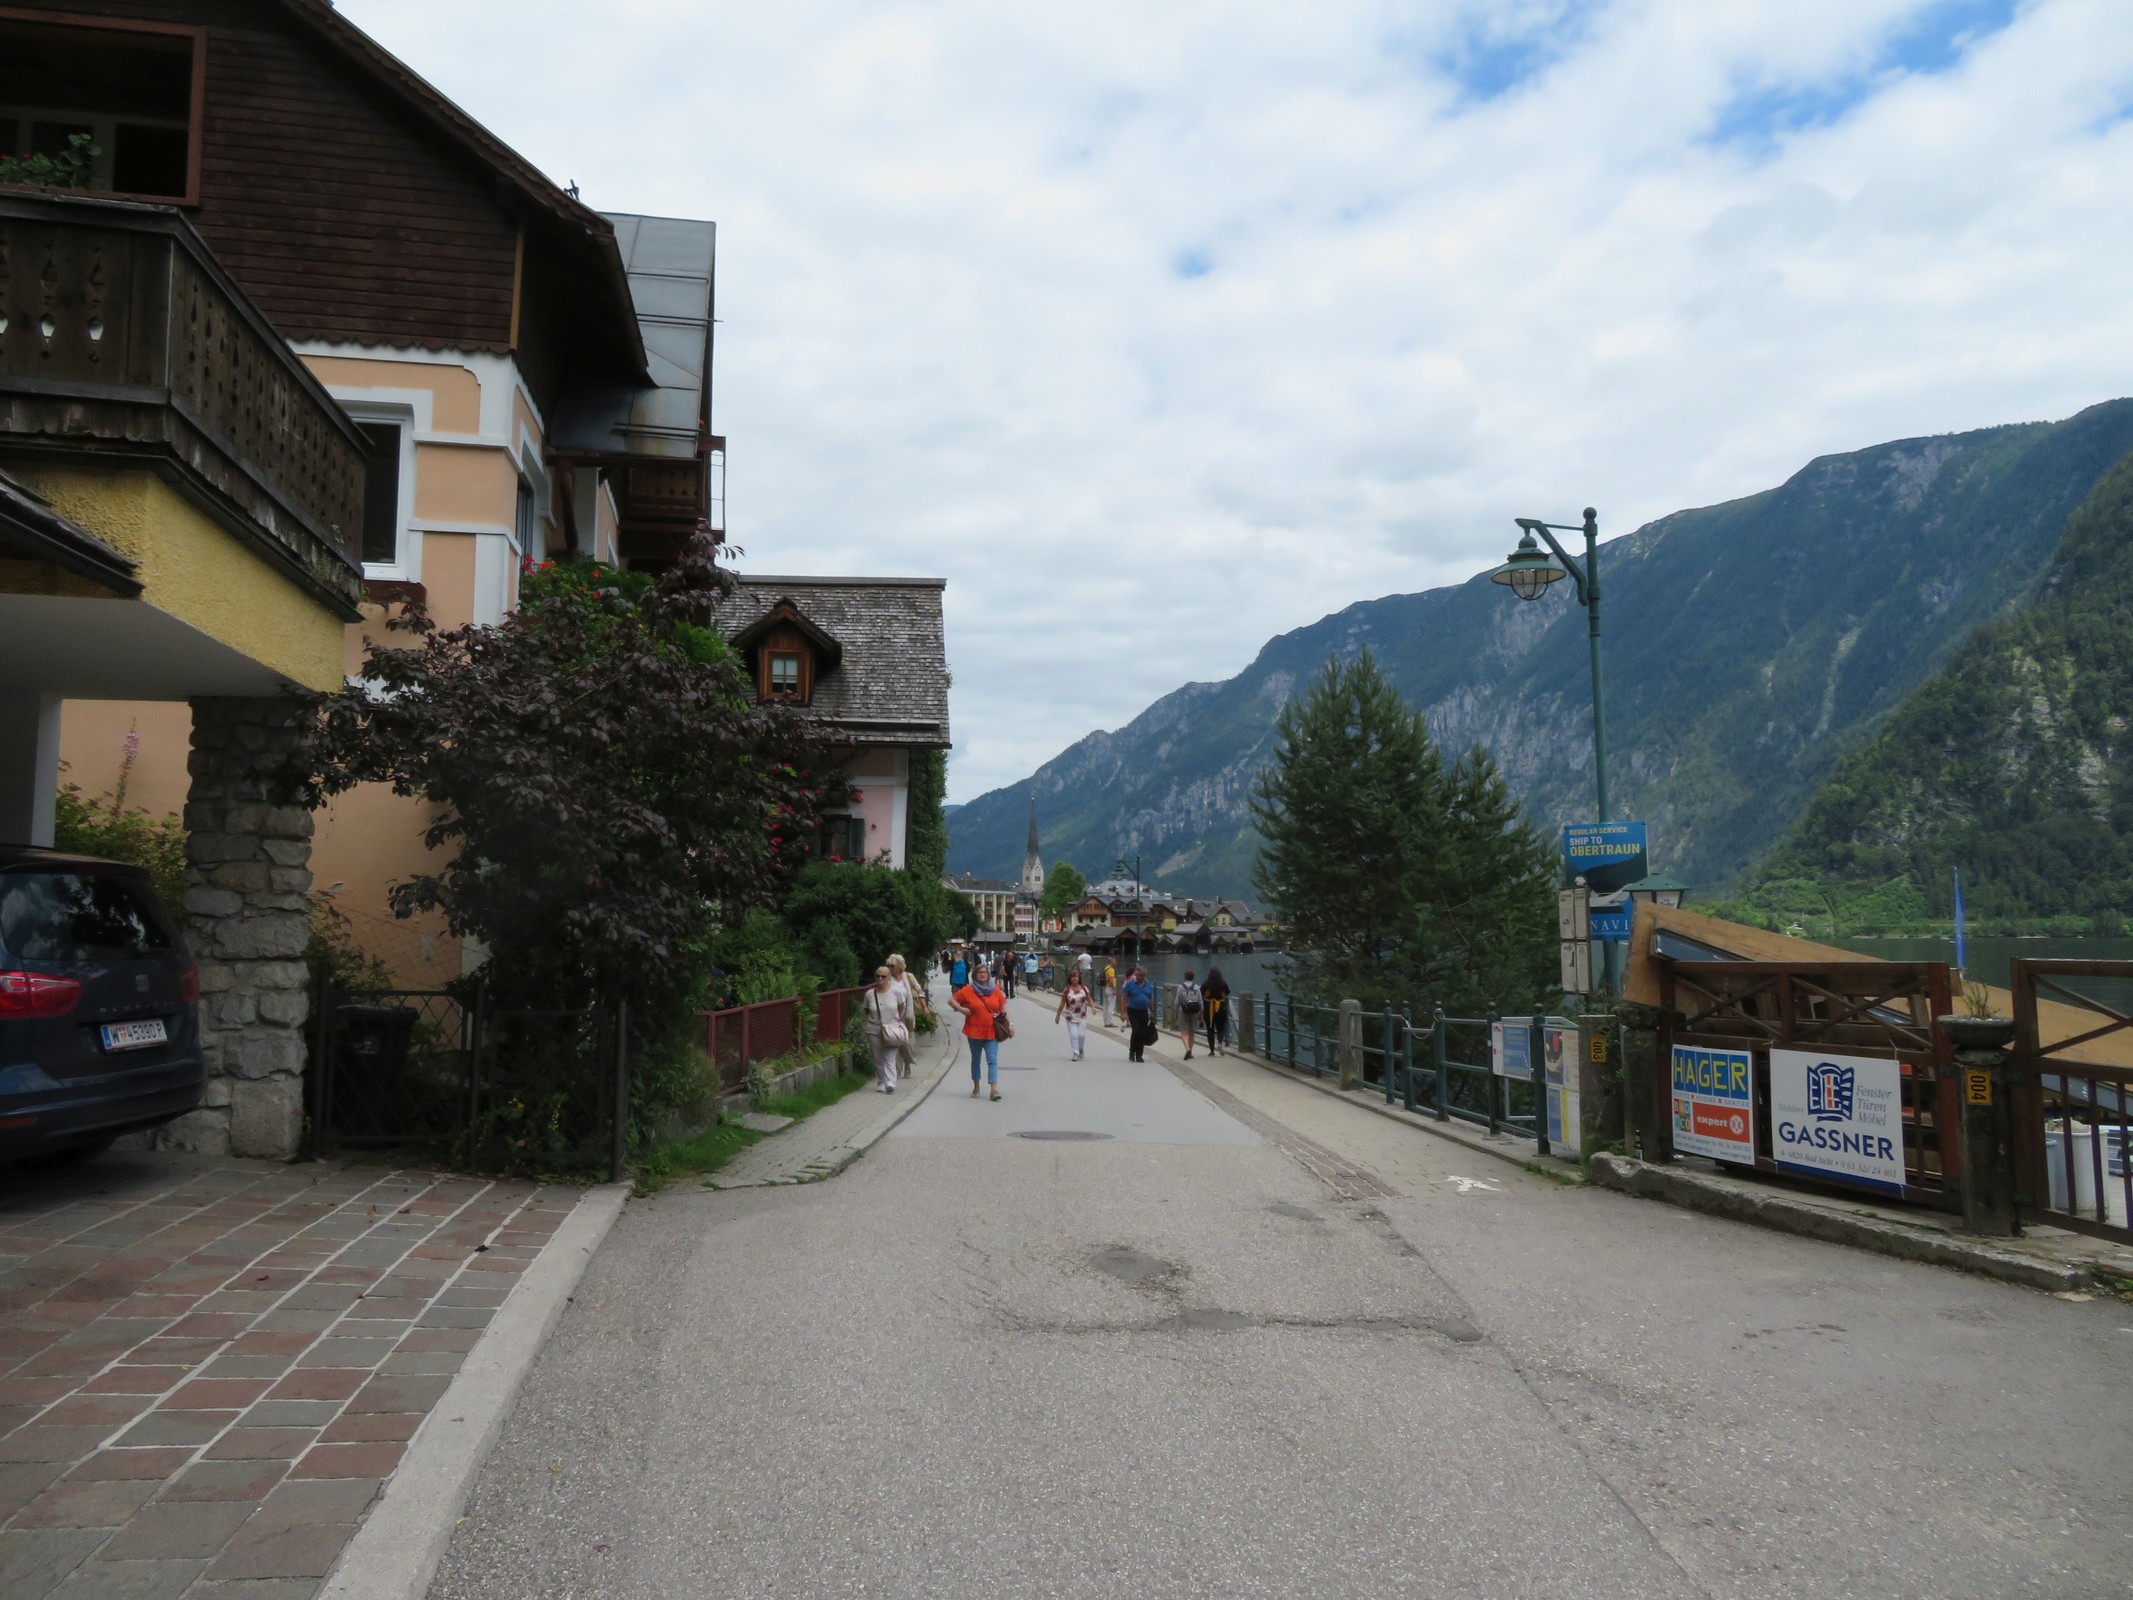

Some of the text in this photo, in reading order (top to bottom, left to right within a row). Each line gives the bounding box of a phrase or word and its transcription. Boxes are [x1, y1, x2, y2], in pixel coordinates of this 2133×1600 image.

[1569, 826, 1628, 836] REGULAR SERVICE
[1569, 836, 1603, 846] SHIP TO
[1570, 843, 1641, 857] OBERTRAUN
[1592, 1042, 1604, 1060] 003
[1674, 1055, 1747, 1092] HAGER
[1856, 1085, 1892, 1099] Fenster
[1970, 1075, 1987, 1101] 004
[1857, 1098, 1887, 1112] Türen
[1696, 1116, 1728, 1127] expert
[1856, 1112, 1887, 1126] Möbel
[1778, 1121, 1895, 1161] GASSNER
[1804, 1153, 1817, 1163] Bad
